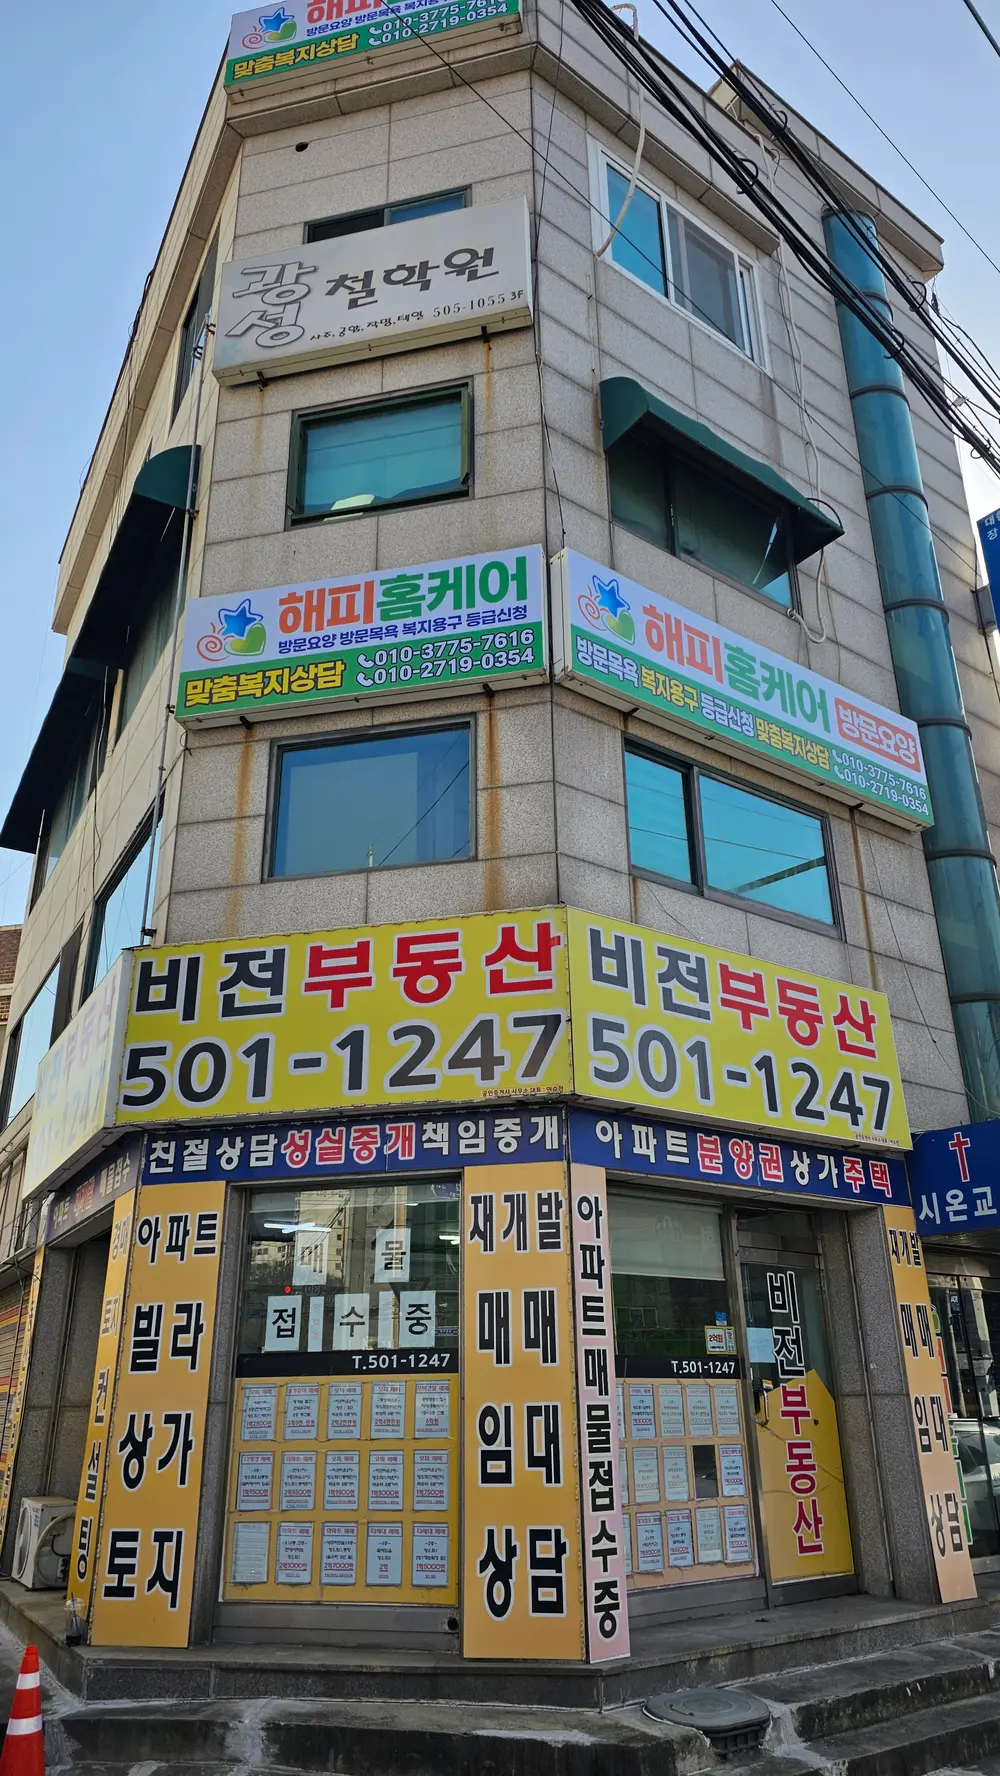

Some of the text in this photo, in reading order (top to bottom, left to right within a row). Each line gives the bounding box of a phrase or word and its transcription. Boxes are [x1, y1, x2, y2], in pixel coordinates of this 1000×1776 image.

[307, 0, 402, 24] 해피
[307, 0, 447, 36] 방문요양 방문목욕 복지용
[382, 4, 508, 42] 010-2719-0354
[383, 0, 506, 31] 010-3775-761
[233, 33, 359, 79] 맞춤복지상담
[325, 247, 499, 310] 철학원
[433, 293, 505, 318] 505-1055
[510, 289, 524, 301] 3F
[278, 556, 528, 634] 해피홈케어
[278, 604, 528, 654] 방문요양 방문목욕 복지용구 등급신청
[373, 628, 535, 667] 010-3775-7616
[184, 659, 346, 707] 맞춤복지상담
[373, 648, 535, 686] 010-2719-0354
[642, 603, 916, 765] 해피홈케어 방문요양
[576, 635, 831, 771] 방문목욕 복지용구 등급신청 맞춤복지상담
[841, 753, 927, 801] 010-3775-7616
[843, 766, 929, 816] 010-2719-0354
[135, 922, 561, 1022] 비전부동산
[588, 926, 876, 1060] 비전부동산
[122, 1014, 562, 1108] 501-1247
[591, 1016, 891, 1131] 501-1247
[470, 1192, 563, 1253] 재개발
[918, 1186, 997, 1226] 시온교
[137, 1212, 219, 1264] 아파트
[888, 1228, 922, 1268] 재개발
[129, 1302, 204, 1374] 빌라
[476, 1289, 560, 1366] 매매
[899, 1302, 935, 1359] 매매
[352, 1354, 451, 1370] T.501-1247
[671, 1360, 735, 1375] T.501-1247
[766, 1271, 825, 1556] 비전부동산
[912, 1394, 949, 1454] 임대
[118, 1412, 194, 1491] 상가
[478, 1402, 563, 1486] 임대
[929, 1491, 965, 1559] 상담
[102, 1529, 184, 1611] 토지
[476, 1525, 568, 1621] 상담
